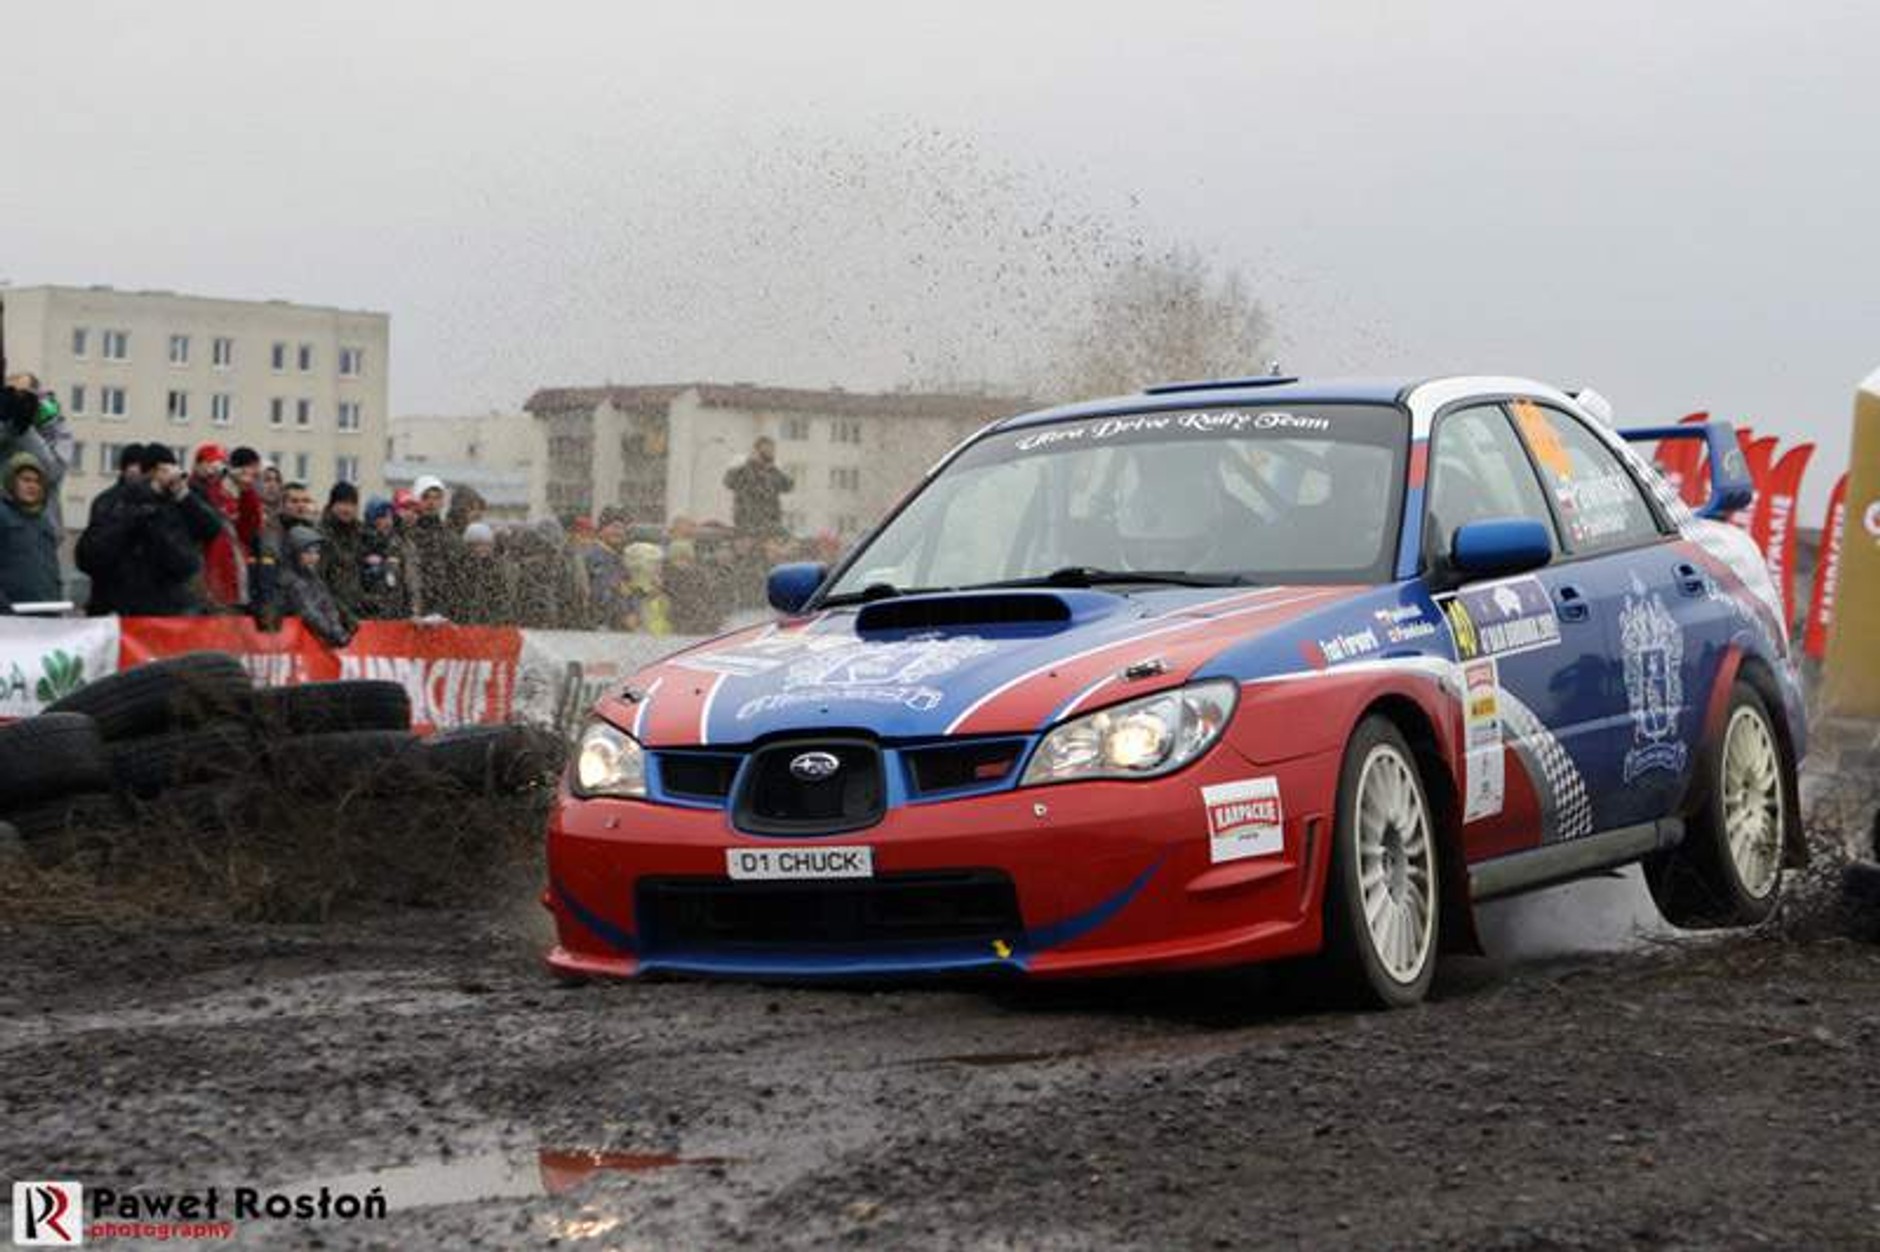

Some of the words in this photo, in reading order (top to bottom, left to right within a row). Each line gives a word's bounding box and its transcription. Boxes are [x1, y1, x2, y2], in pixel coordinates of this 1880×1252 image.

[1177, 411, 1250, 431] Rally
[1254, 411, 1330, 430] Team
[778, 851, 860, 871] CHUCK
